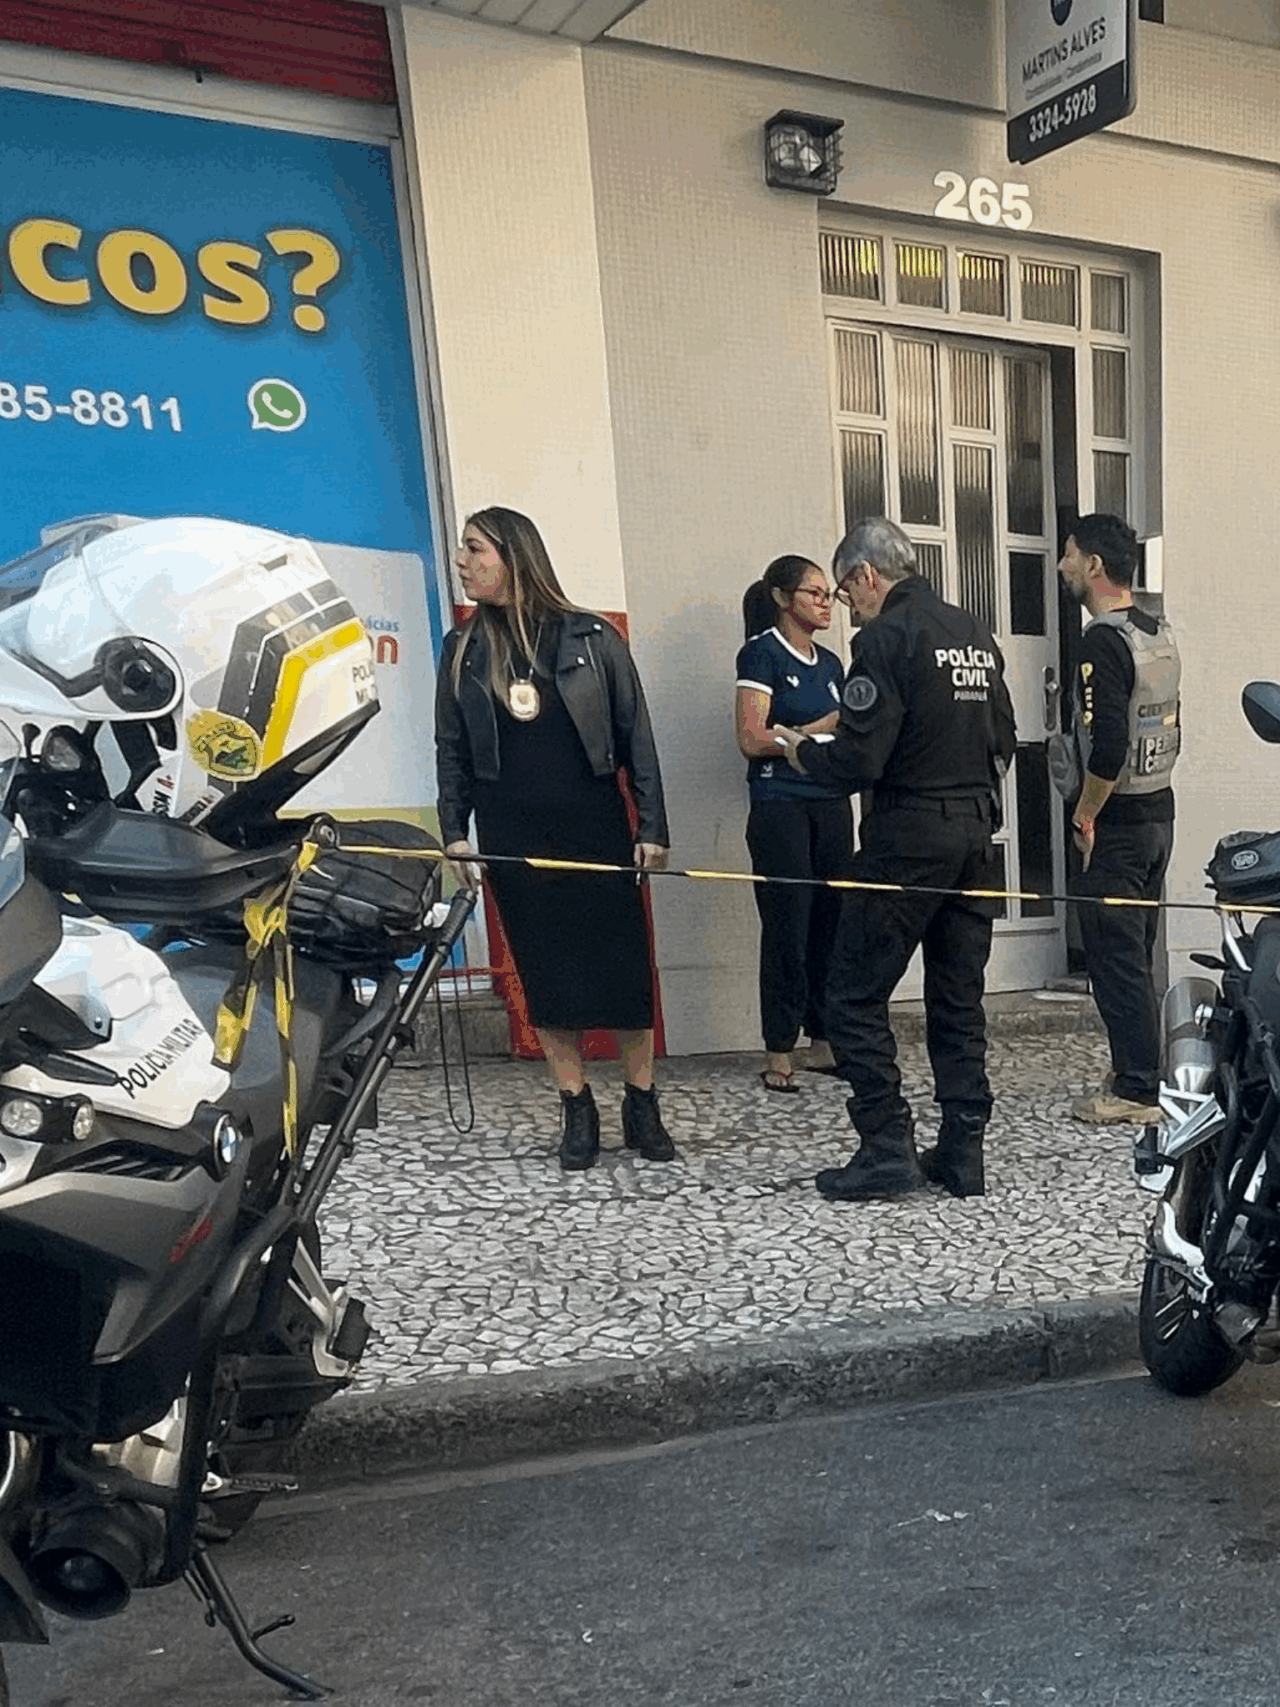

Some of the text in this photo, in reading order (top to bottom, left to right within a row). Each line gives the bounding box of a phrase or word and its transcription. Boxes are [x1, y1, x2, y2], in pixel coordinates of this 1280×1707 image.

[1022, 38, 1068, 82] MARTINS
[1070, 16, 1106, 55] ALVES
[1028, 84, 1097, 142] 3324-5928
[934, 171, 1033, 230] 265
[934, 645, 996, 670] POLÍCIA
[952, 668, 990, 687] CIVIL
[157, 1018, 205, 1057] MILITAR
